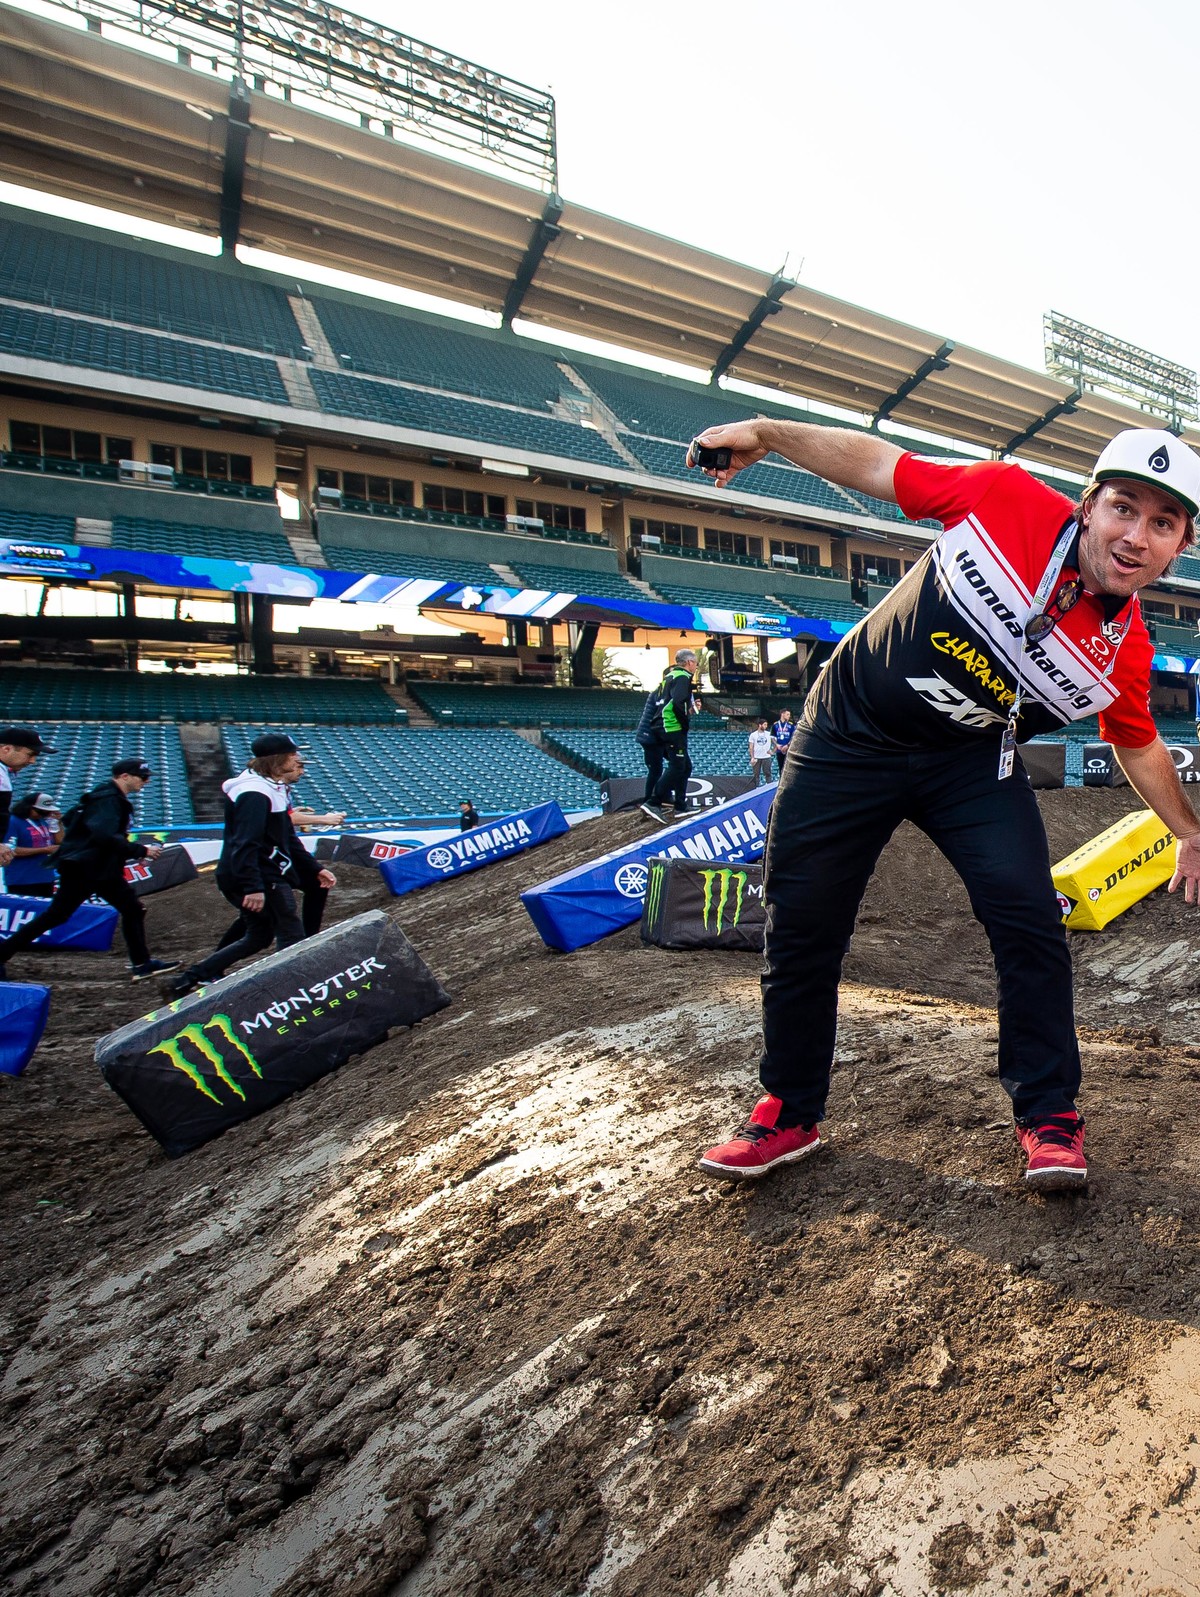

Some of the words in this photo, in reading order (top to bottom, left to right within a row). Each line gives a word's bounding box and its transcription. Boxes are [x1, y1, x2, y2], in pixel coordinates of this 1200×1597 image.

[955, 549, 1024, 639] Honda
[1080, 638, 1107, 667] OAKLEY
[443, 837, 530, 874] RACING
[449, 818, 532, 861] YAMAHA
[240, 956, 387, 1035] MONSTER
[276, 981, 372, 1036] ENERGY
